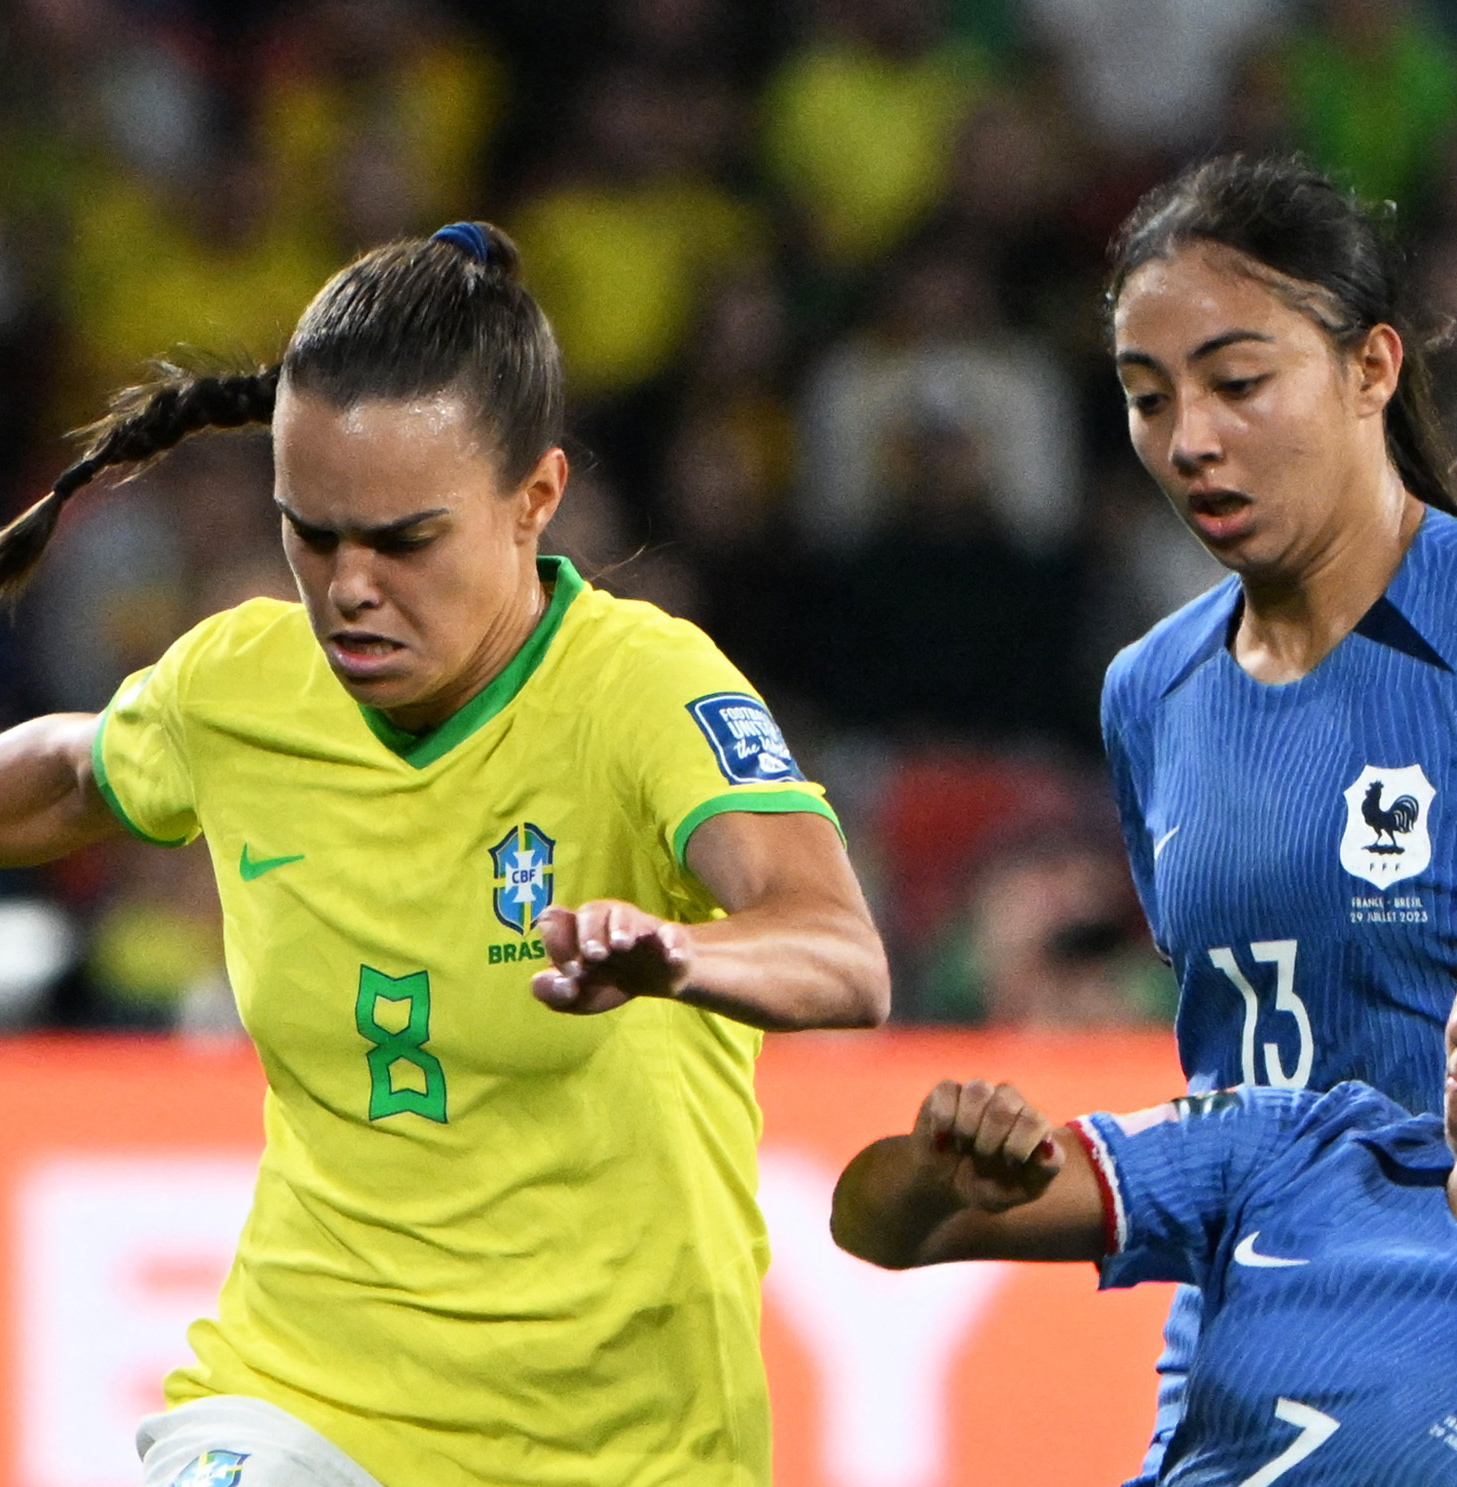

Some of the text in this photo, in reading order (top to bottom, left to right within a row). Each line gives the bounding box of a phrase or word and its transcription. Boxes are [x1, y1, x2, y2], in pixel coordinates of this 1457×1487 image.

[511, 868, 536, 884] CBF
[1350, 911, 1364, 924] 29
[1399, 911, 1428, 923] 2023
[488, 939, 546, 965] BRAS
[1208, 939, 1314, 1090] 13
[354, 963, 449, 1125] 8
